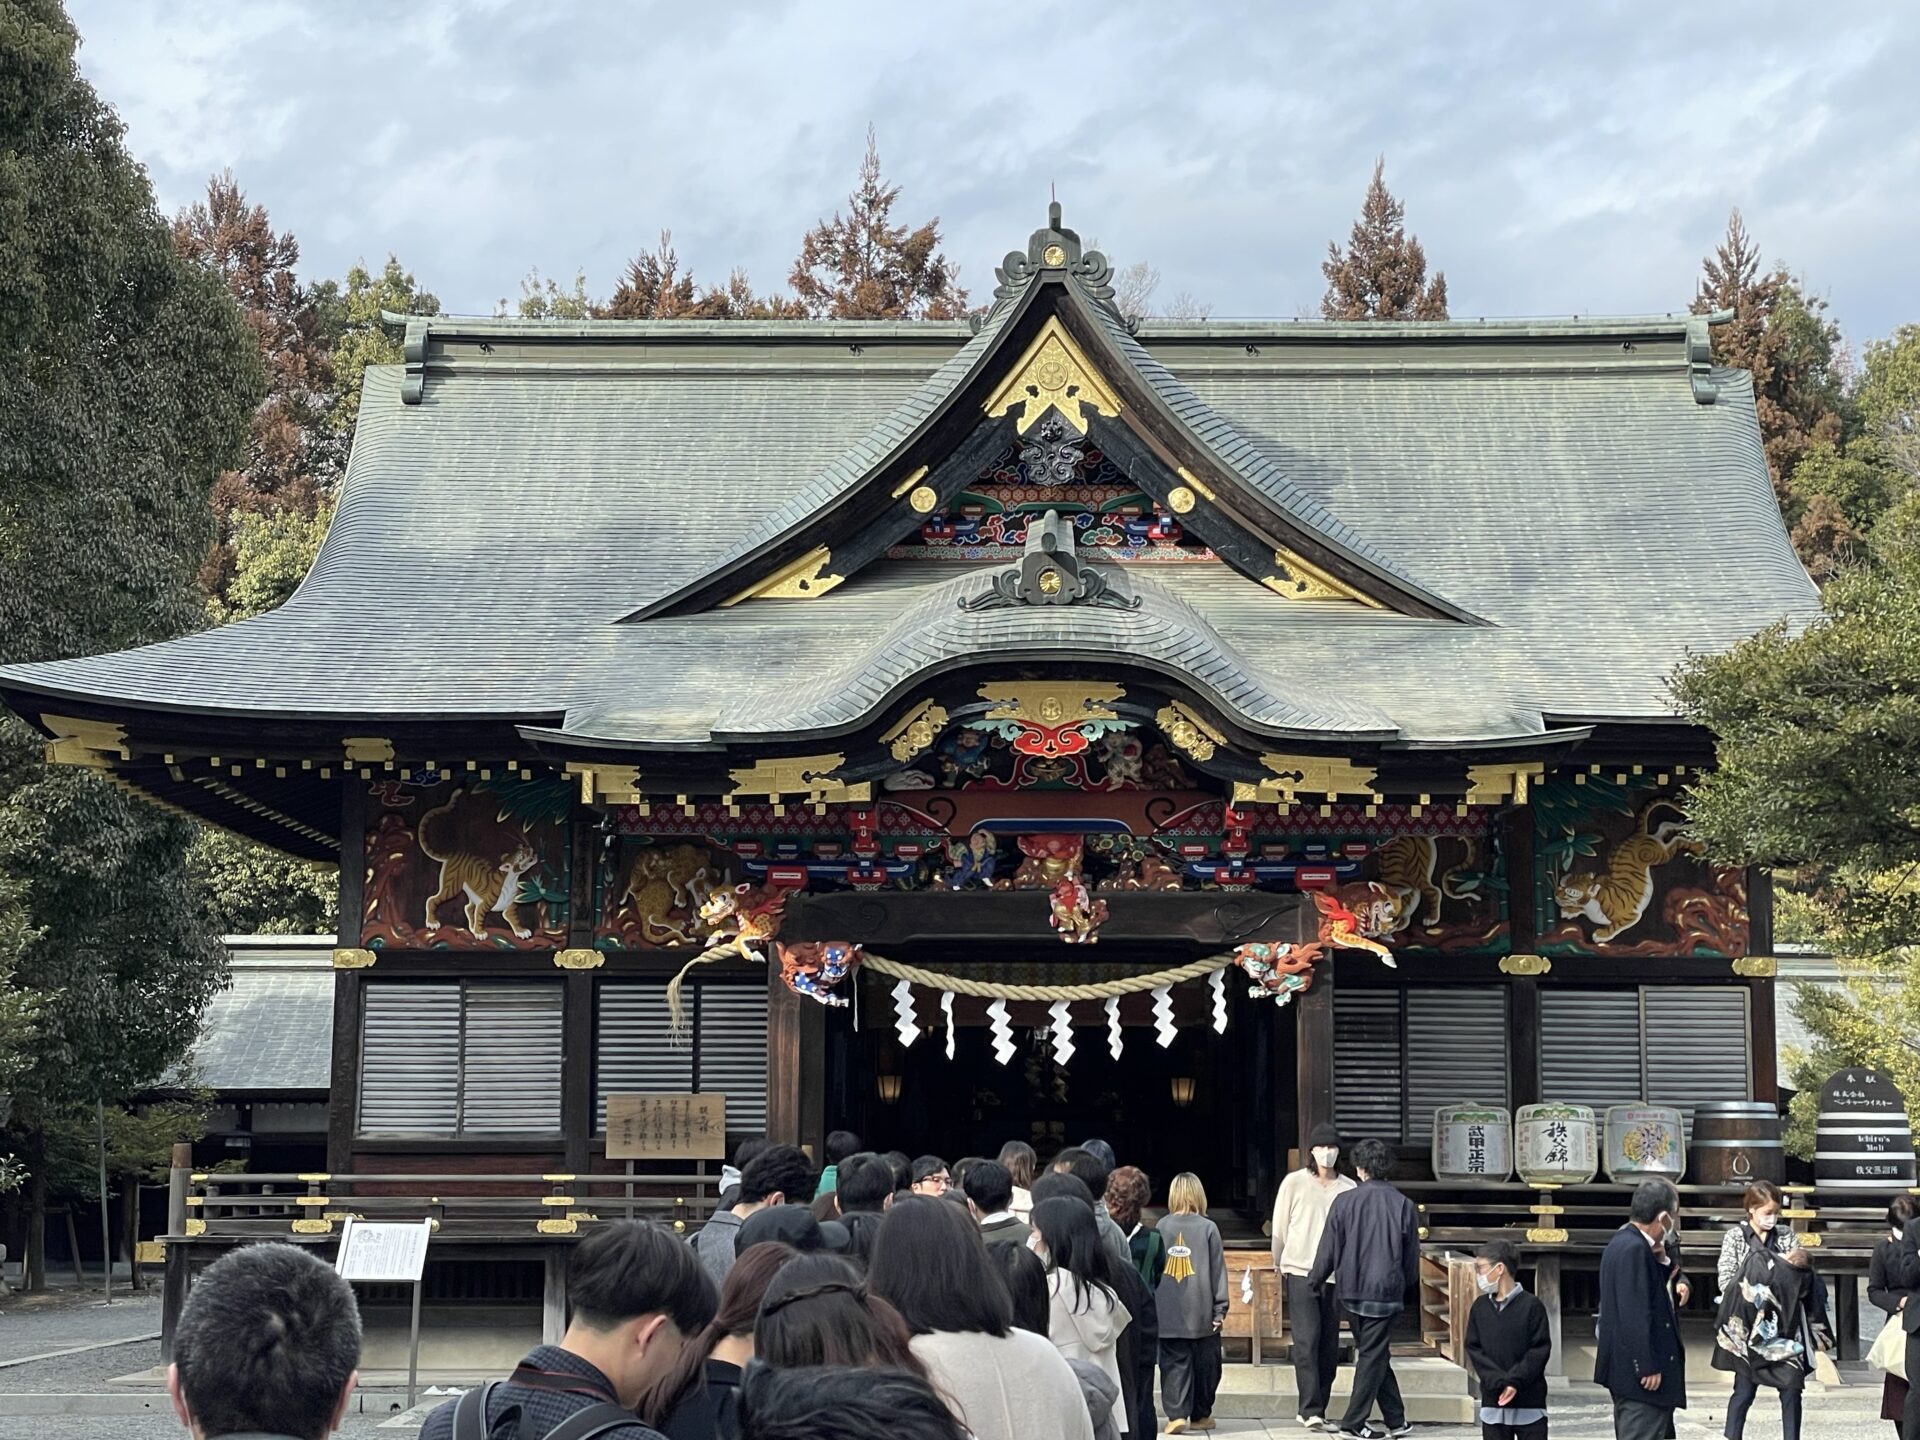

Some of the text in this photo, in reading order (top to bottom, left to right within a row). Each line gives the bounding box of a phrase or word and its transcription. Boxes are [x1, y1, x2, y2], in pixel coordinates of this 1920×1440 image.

[1468, 1125, 1485, 1172] 武甲正宗
[1542, 1120, 1568, 1171] 秩父錦
